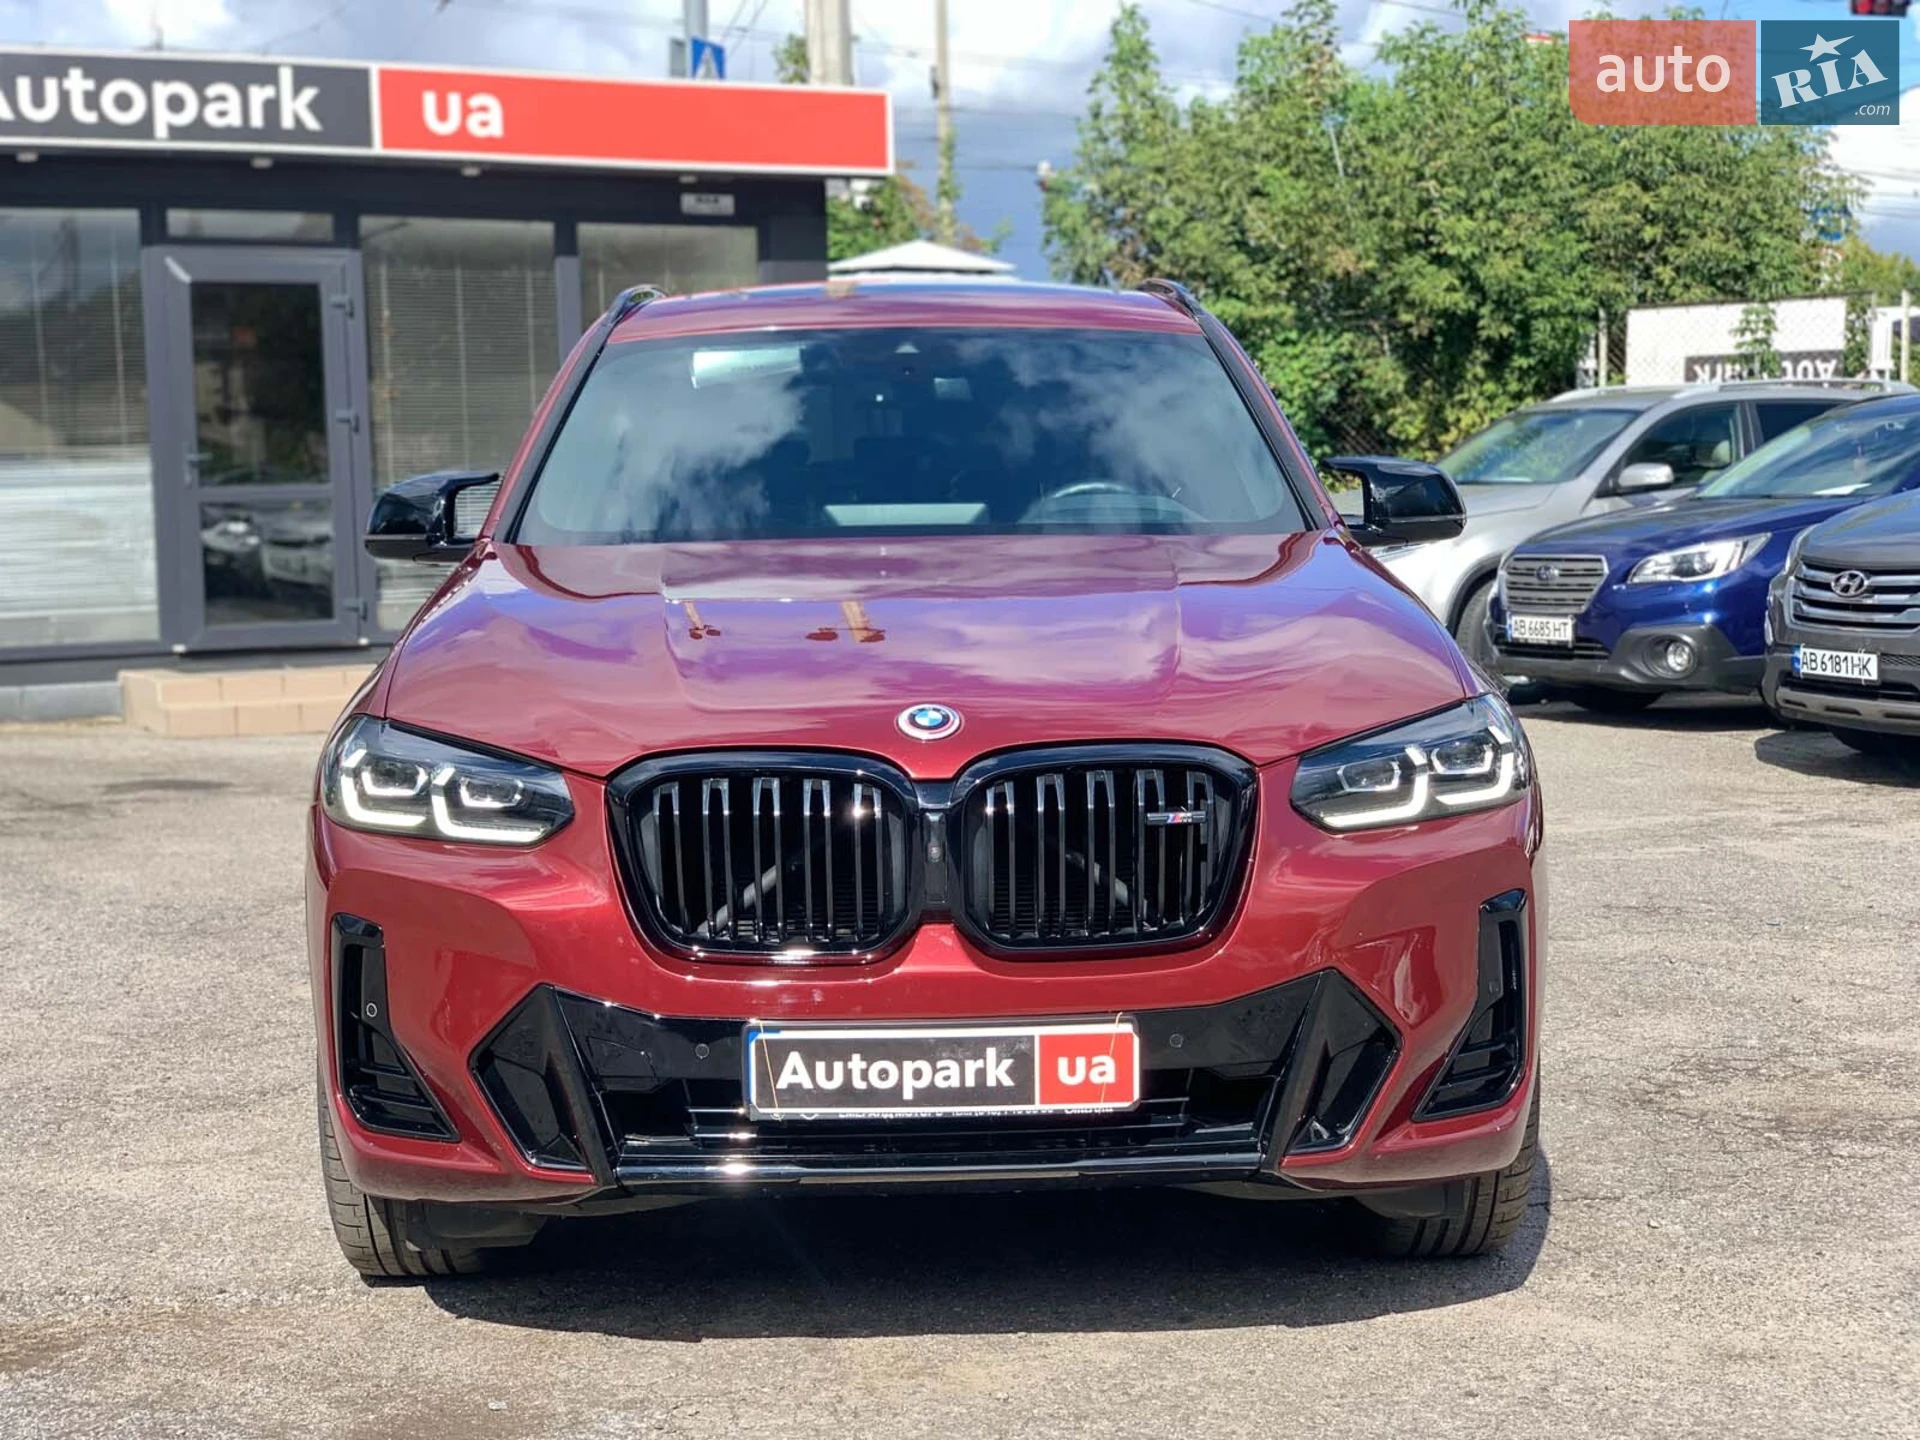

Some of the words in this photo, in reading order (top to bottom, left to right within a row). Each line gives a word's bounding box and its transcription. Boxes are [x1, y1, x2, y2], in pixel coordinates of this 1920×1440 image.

[0, 65, 323, 140] utopark
[422, 90, 505, 138] ua
[776, 1047, 1015, 1100] Autopark
[1057, 1054, 1117, 1086] ua
